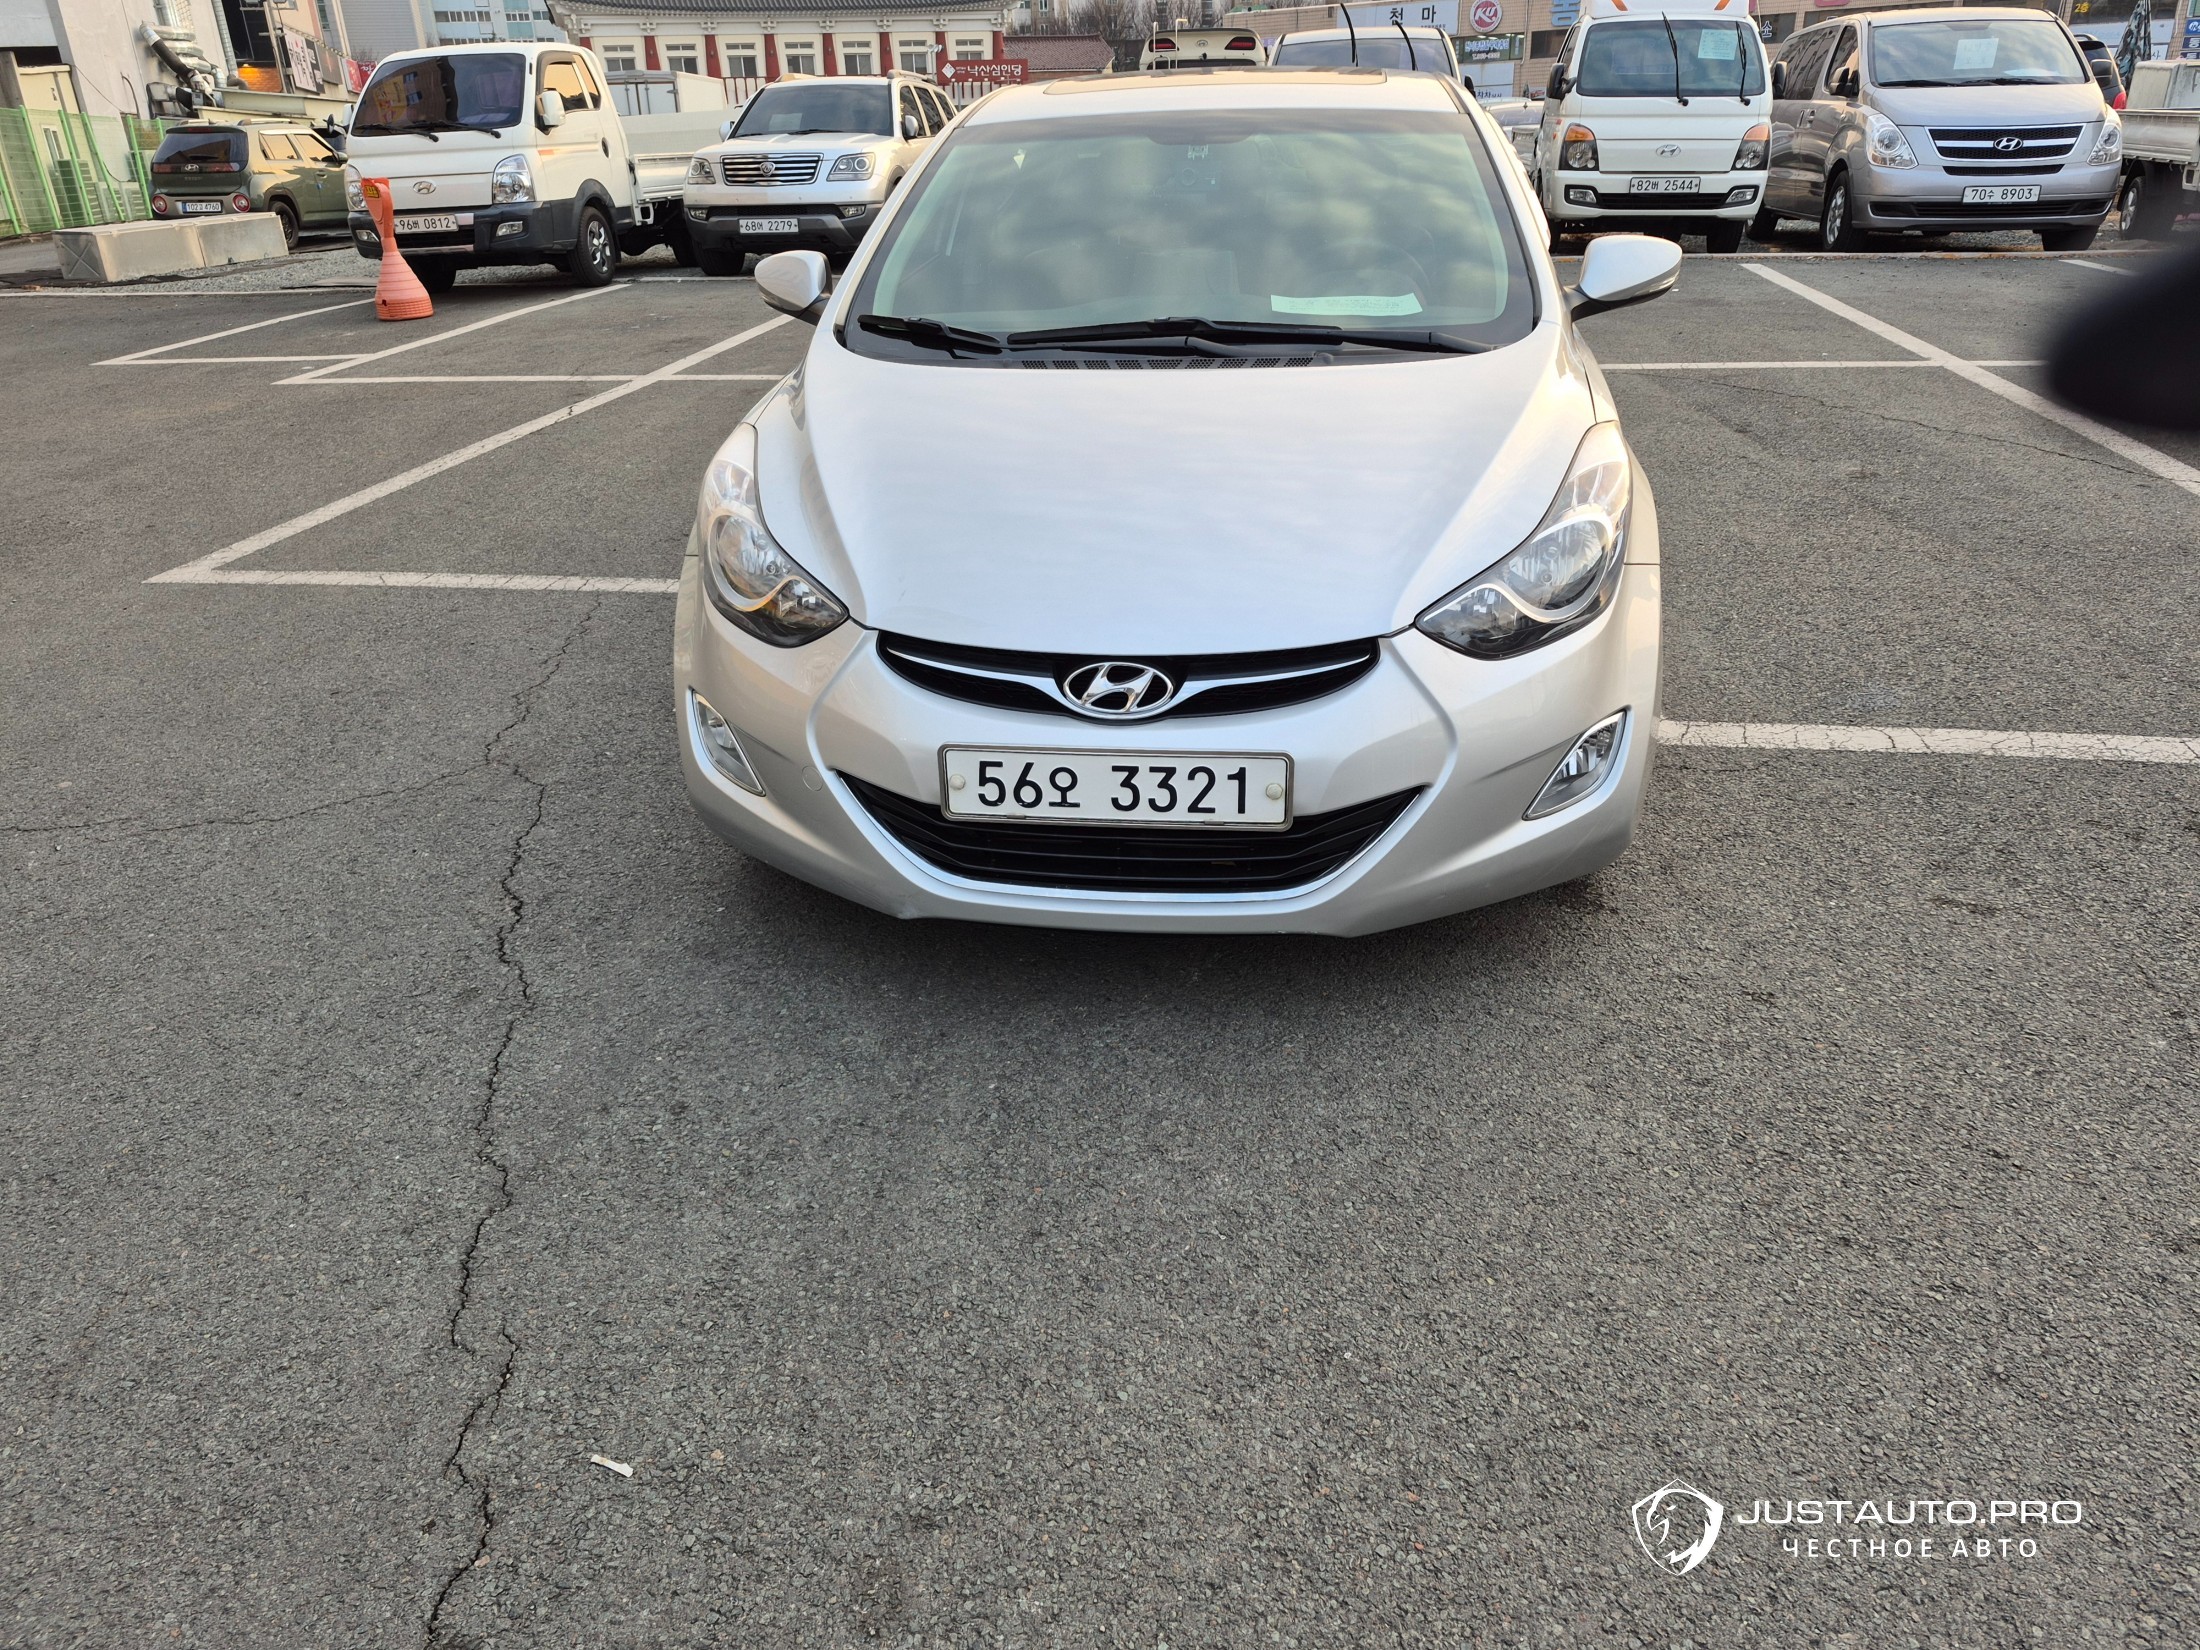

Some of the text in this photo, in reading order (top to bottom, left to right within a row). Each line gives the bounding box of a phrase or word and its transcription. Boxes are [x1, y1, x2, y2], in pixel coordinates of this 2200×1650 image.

[967, 64, 1023, 77] 낙산심인당
[1636, 179, 1694, 191] 82버 2544
[1971, 188, 2033, 201] 70수 8903
[399, 217, 451, 231] 96버 0812
[745, 220, 793, 232] 68어 2279
[977, 760, 1247, 815] 56오 3321
